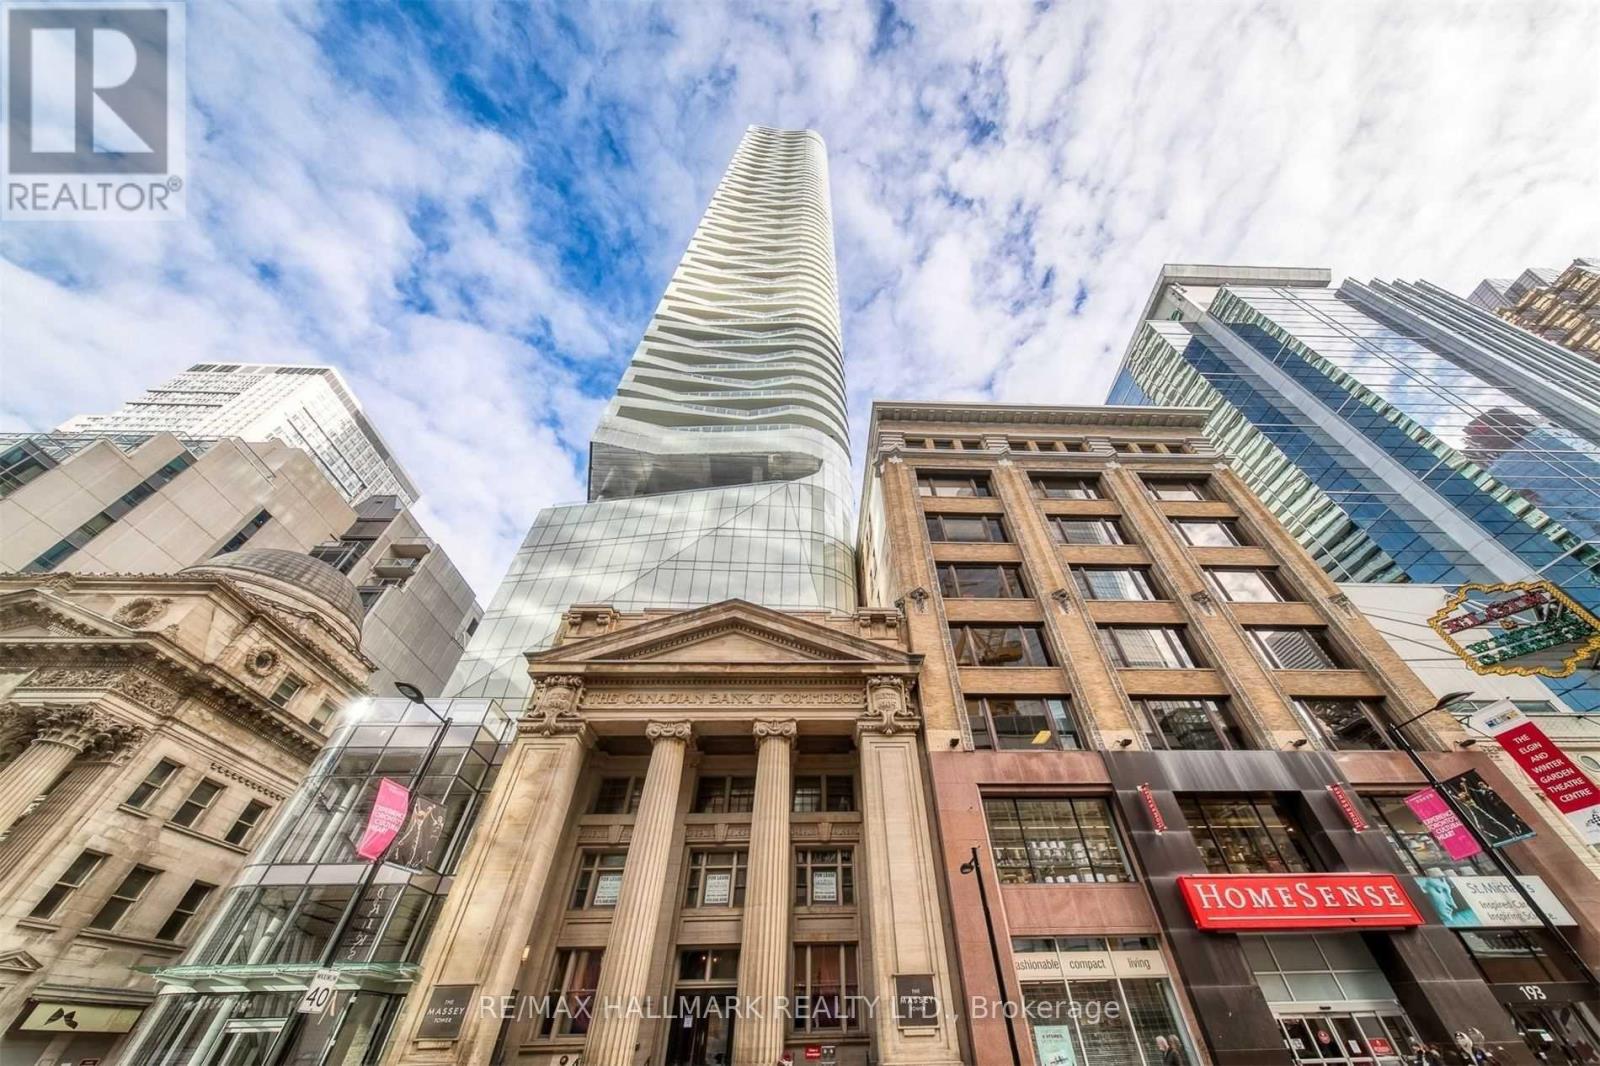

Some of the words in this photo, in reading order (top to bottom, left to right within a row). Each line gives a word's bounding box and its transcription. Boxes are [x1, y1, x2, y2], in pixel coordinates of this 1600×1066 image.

[589, 693, 619, 705] THE
[623, 693, 704, 705] CANADIAN
[708, 693, 754, 705] BANK
[759, 693, 777, 705] OF
[782, 693, 861, 705] COMMERCE
[1512, 733, 1531, 744] THE
[1519, 741, 1543, 755] ELGIN
[1530, 752, 1549, 763] AND
[1531, 758, 1566, 774] WINTER
[1540, 767, 1575, 784] GARDEN
[1547, 777, 1586, 794] THEATRE
[1559, 788, 1593, 802] CENTRE
[1015, 959, 1060, 971] ashionable
[1069, 958, 1106, 971] compact
[1127, 957, 1152, 970] living
[305, 986, 330, 1007] 40
[1519, 985, 1548, 1001] 193
[427, 1007, 466, 1016] MASSEY
